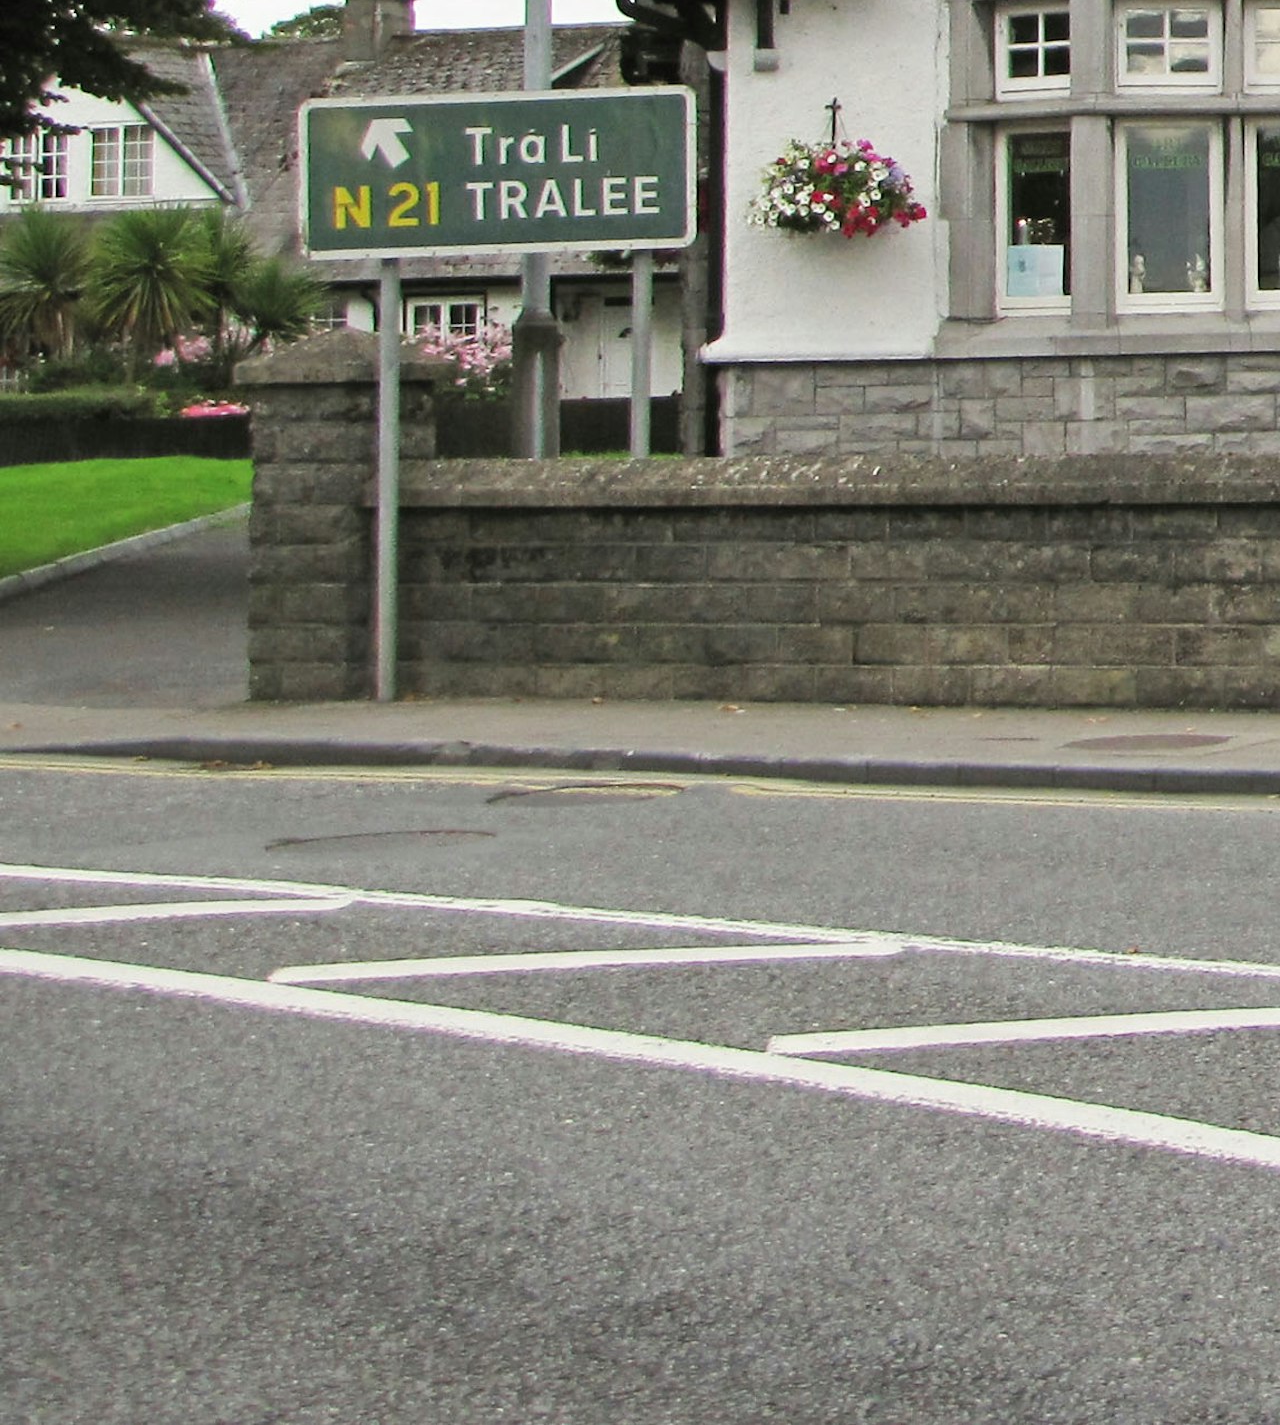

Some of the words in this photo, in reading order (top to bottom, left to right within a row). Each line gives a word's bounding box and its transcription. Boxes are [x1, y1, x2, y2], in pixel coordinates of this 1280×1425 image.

[464, 126, 547, 166] Trá
[561, 123, 598, 163] Lí
[333, 185, 372, 230] N
[387, 181, 441, 228] 21
[465, 176, 661, 222] TRALEE
